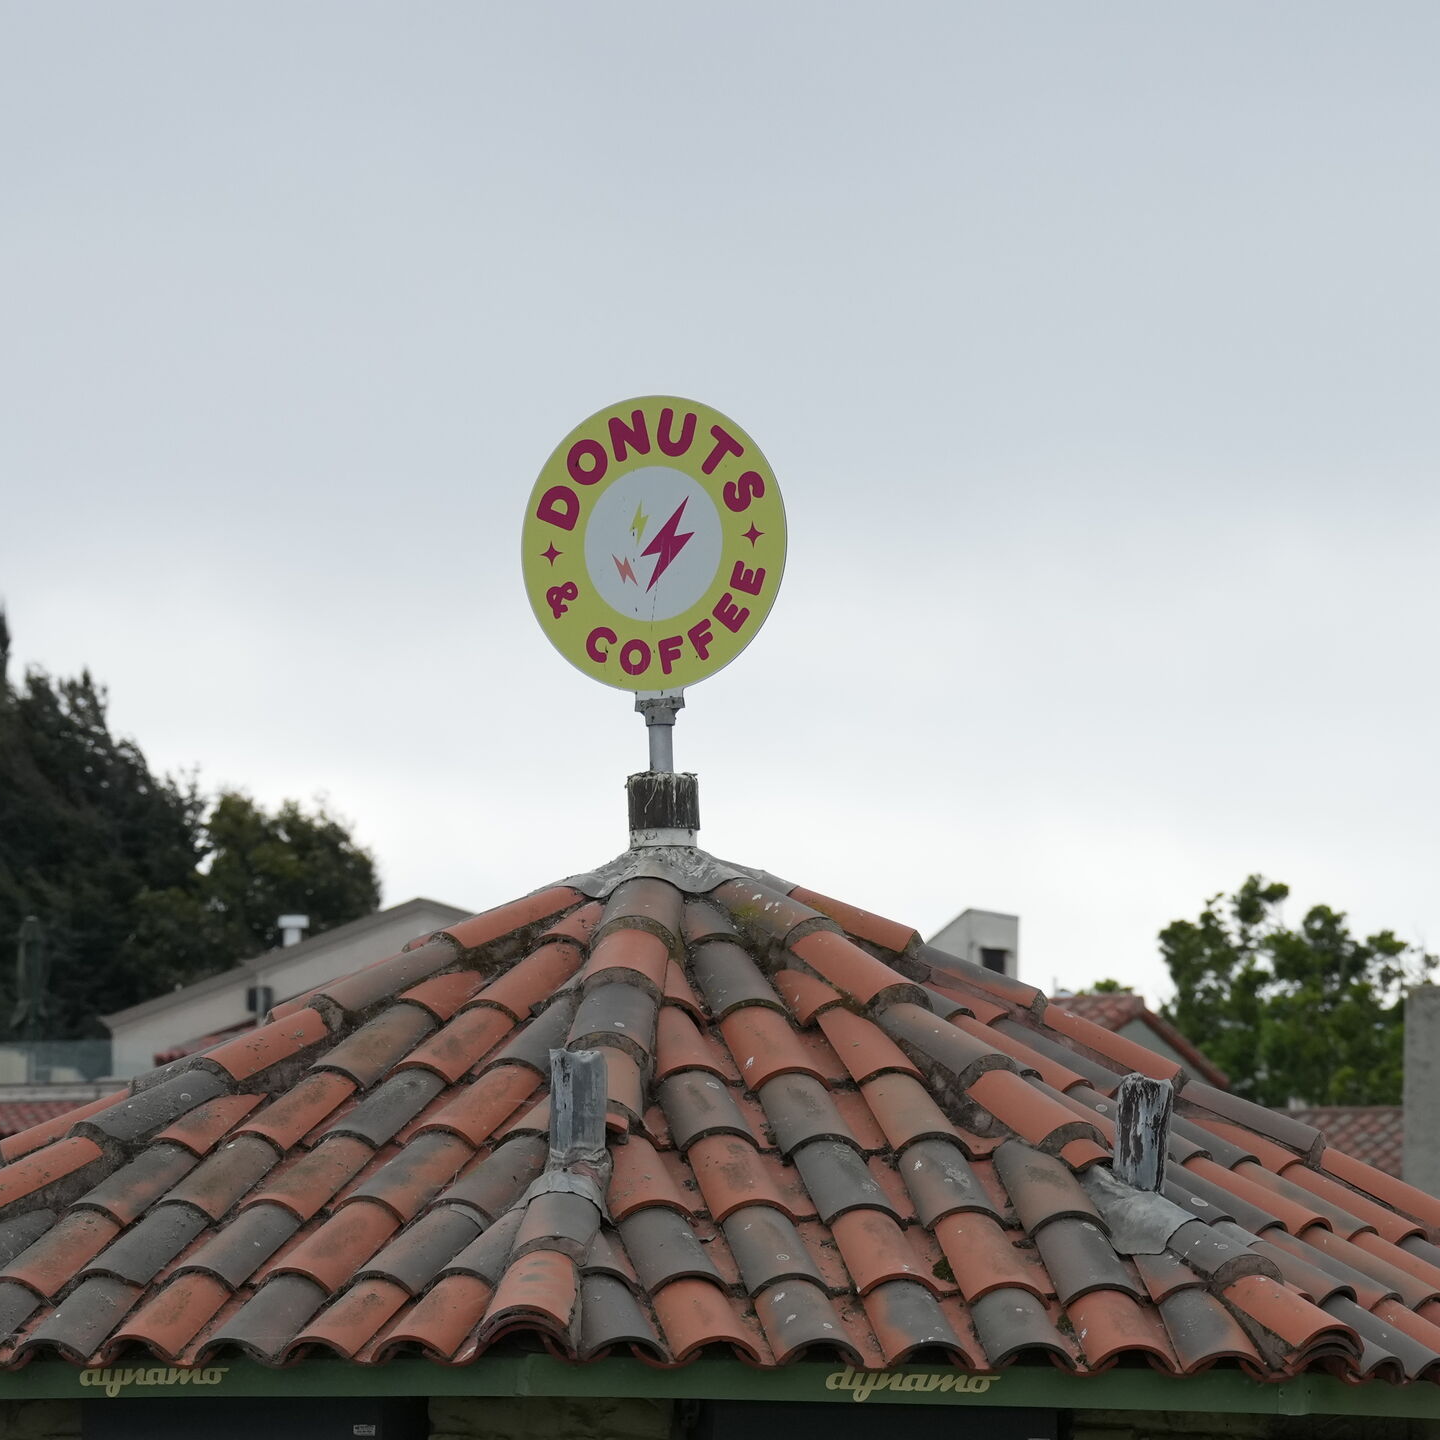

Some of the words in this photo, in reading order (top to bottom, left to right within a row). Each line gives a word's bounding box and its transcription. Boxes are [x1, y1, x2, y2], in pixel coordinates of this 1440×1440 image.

[536, 408, 765, 531] DONUTS
[546, 581, 578, 619] &
[586, 560, 766, 675] COFFEE
[825, 1365, 1001, 1402] dynamo
